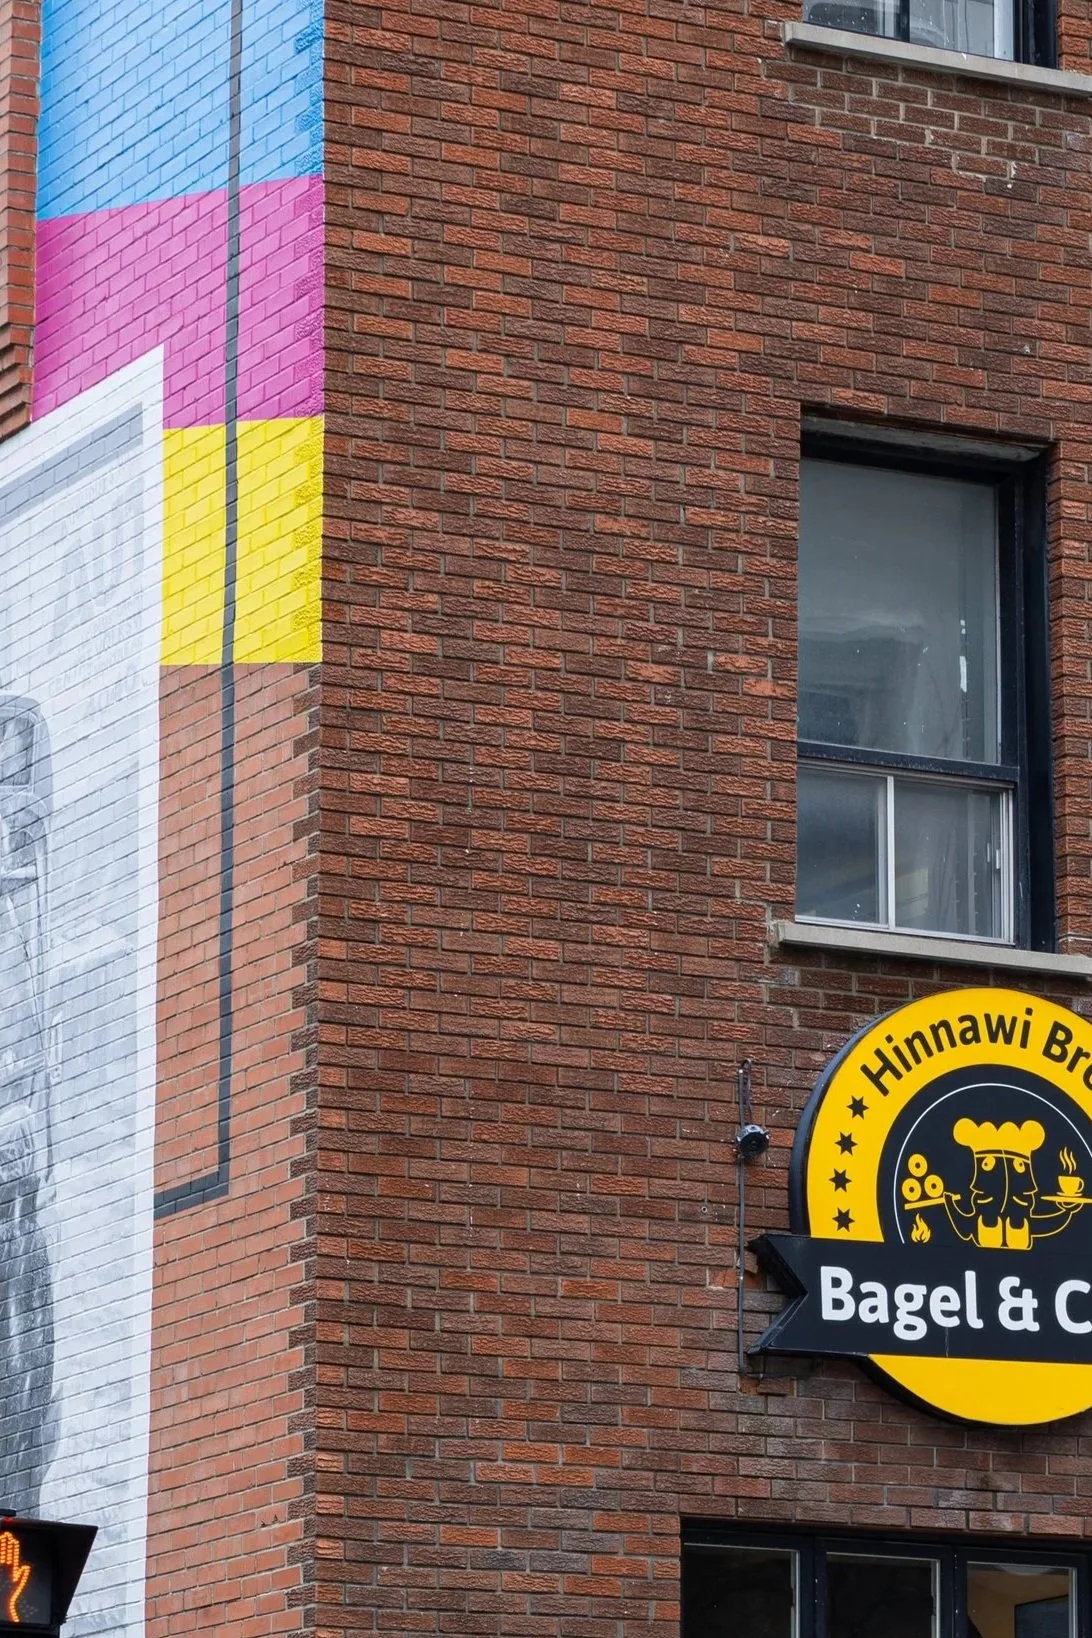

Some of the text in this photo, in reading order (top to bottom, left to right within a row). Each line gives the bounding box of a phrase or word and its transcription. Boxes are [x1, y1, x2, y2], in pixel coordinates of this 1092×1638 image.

[860, 1007, 1034, 1097] Hinnawi
[819, 1264, 984, 1341] Bagel
[998, 1276, 1041, 1332] &
